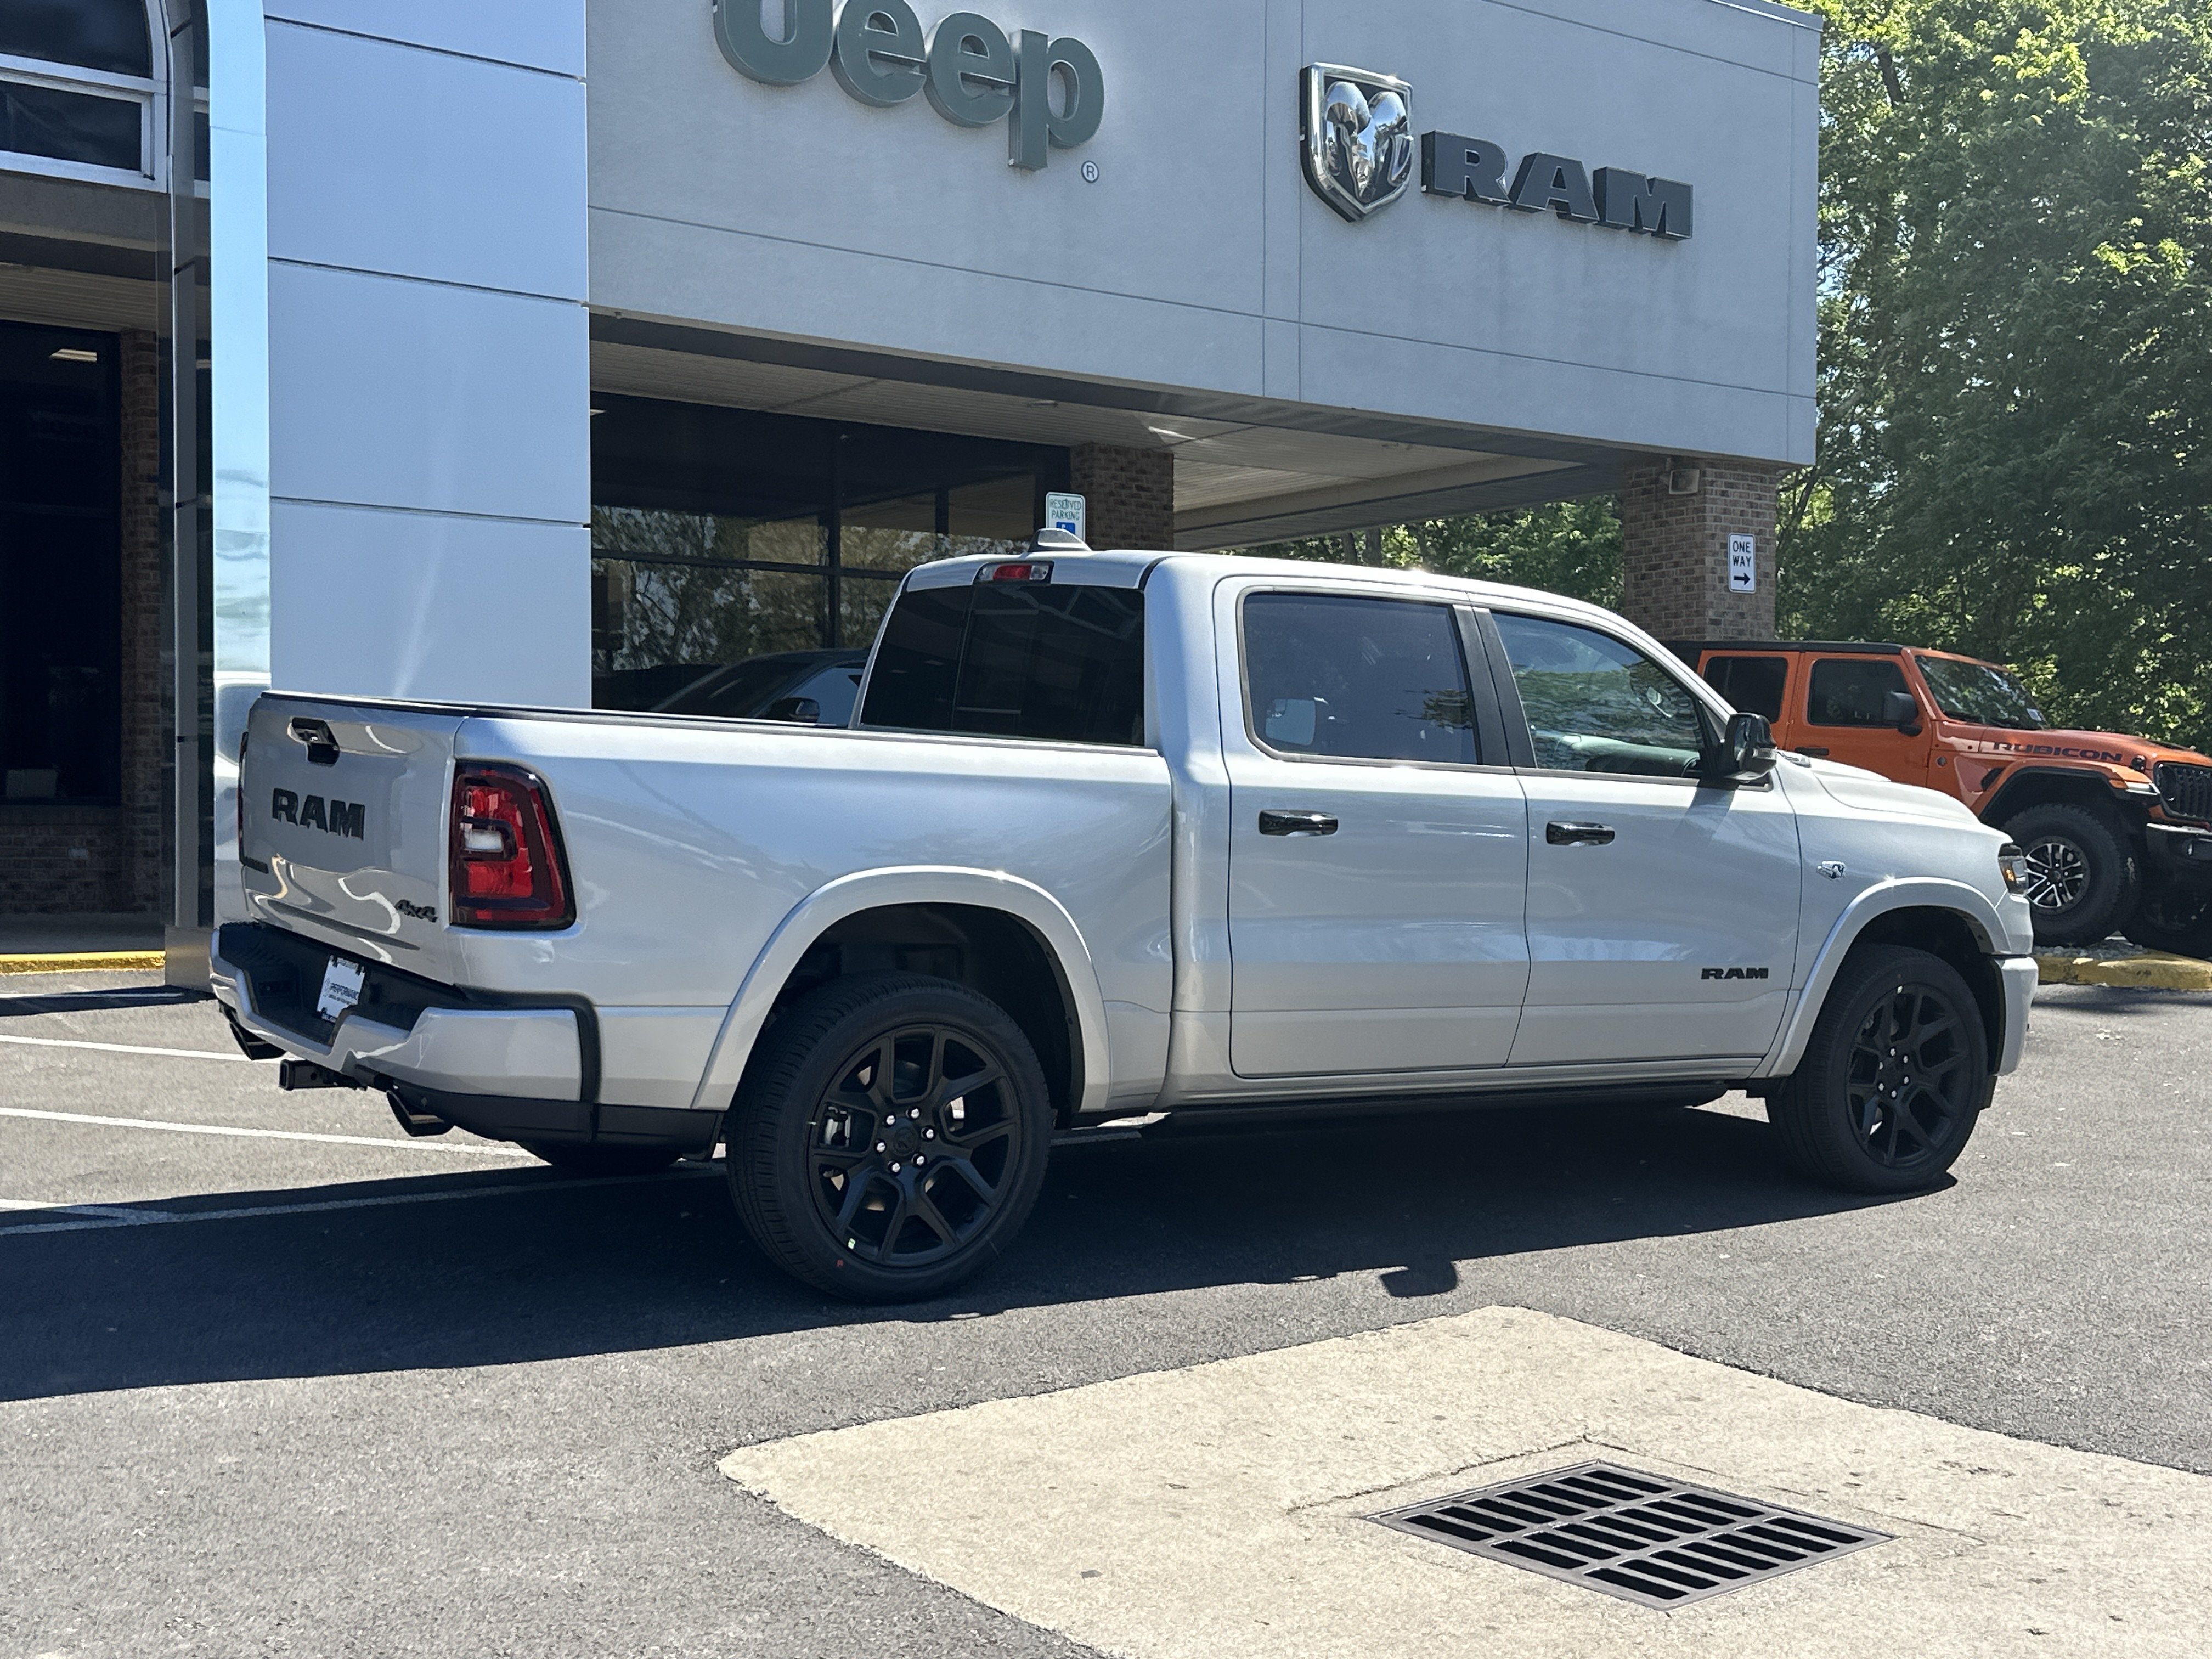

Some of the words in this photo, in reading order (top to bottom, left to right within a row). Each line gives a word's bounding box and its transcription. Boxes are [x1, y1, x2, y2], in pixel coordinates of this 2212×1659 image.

[1422, 130, 1693, 240] RAM
[1049, 499, 1081, 510] RESERVED
[1052, 510, 1080, 521] PARKING
[1733, 540, 1751, 553] ONE
[1733, 555, 1751, 567] WAY
[1993, 742, 2122, 761] RUBICON
[272, 788, 365, 841] RAM
[1701, 968, 1769, 980] RAM
